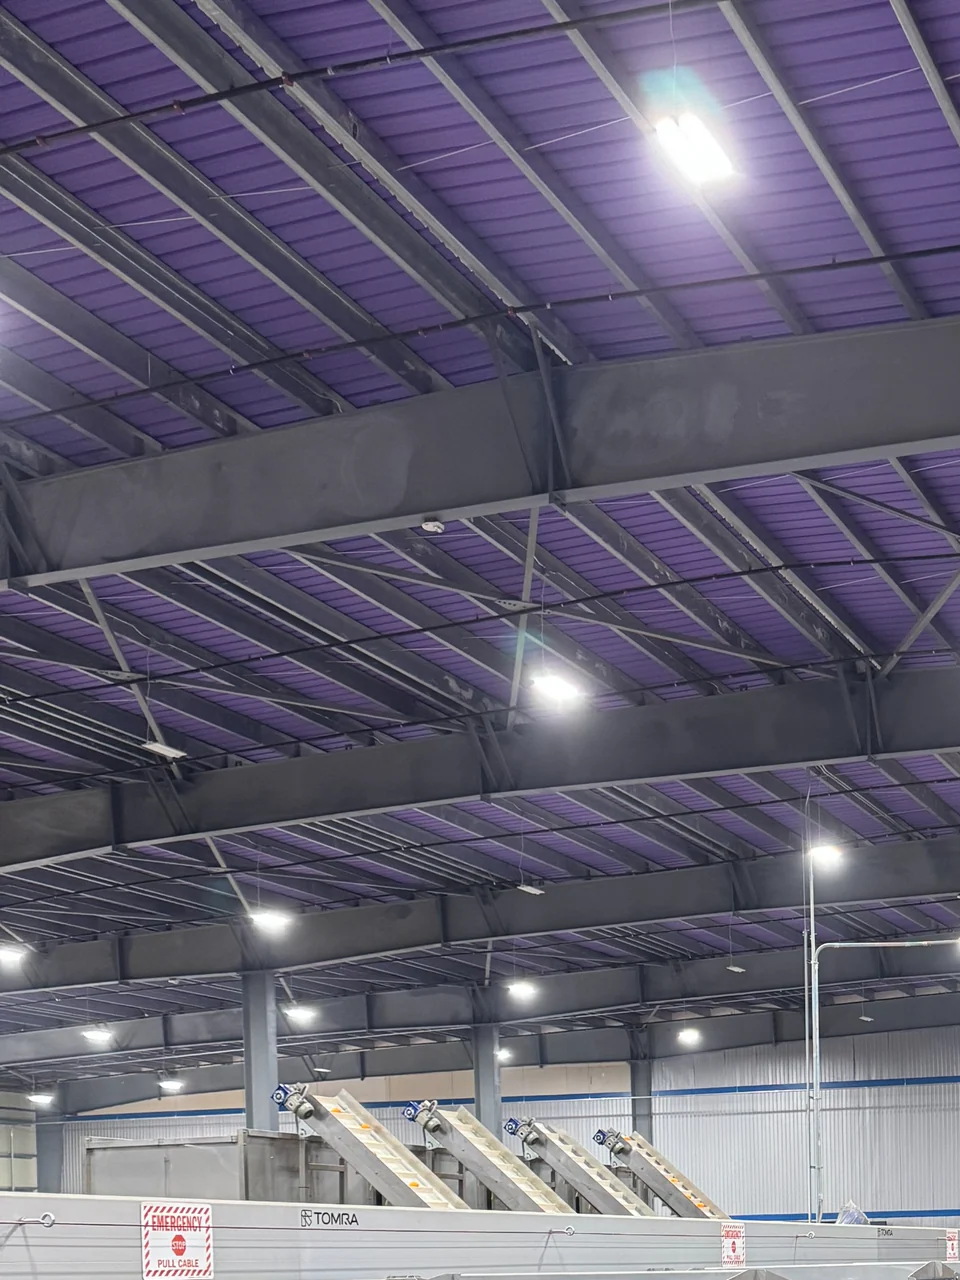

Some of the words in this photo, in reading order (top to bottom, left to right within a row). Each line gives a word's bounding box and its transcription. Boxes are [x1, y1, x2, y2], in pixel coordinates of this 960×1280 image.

[151, 1215, 203, 1232] EMERGENCY
[314, 1211, 360, 1227] TOMRA
[172, 1240, 187, 1251] STOP
[157, 1259, 176, 1268] PULL
[178, 1259, 200, 1268] CABLE
